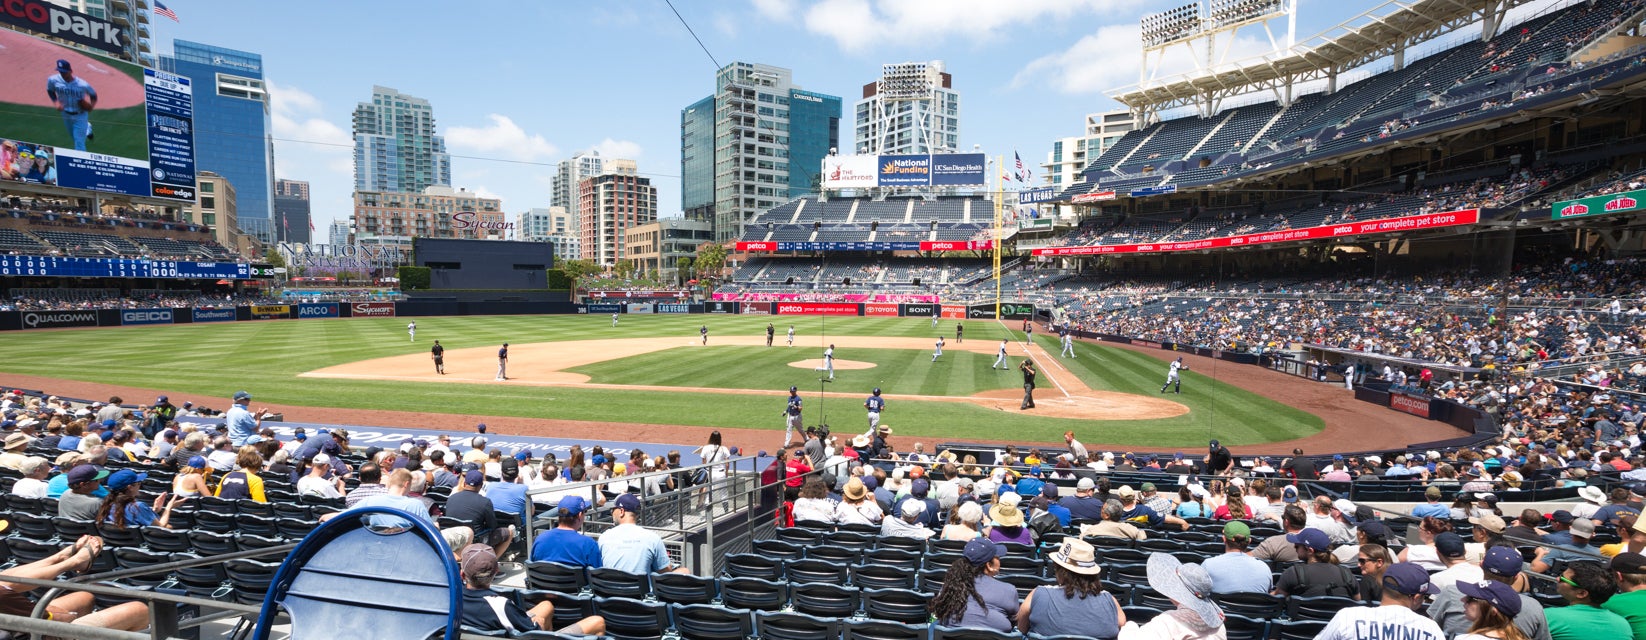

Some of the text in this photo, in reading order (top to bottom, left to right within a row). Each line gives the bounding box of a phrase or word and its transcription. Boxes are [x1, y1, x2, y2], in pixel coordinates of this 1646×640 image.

[50, 8, 122, 47] park
[155, 187, 192, 198] coloredge
[1021, 190, 1052, 202] LAS VEGAS
[1606, 199, 1618, 210] PAPA
[452, 212, 516, 232] Sycuan
[1334, 225, 1352, 235] petco
[1360, 222, 1378, 231] your
[1379, 219, 1415, 229] complete
[1432, 214, 1455, 224] store
[1260, 233, 1284, 242] complete
[250, 267, 274, 276] iboss
[356, 304, 390, 315] Sycuan
[25, 313, 95, 327] QUALCOMM
[124, 312, 172, 321] GEICO
[1394, 396, 1428, 412] petco.com
[487, 441, 633, 456] BIENVEIDOS
